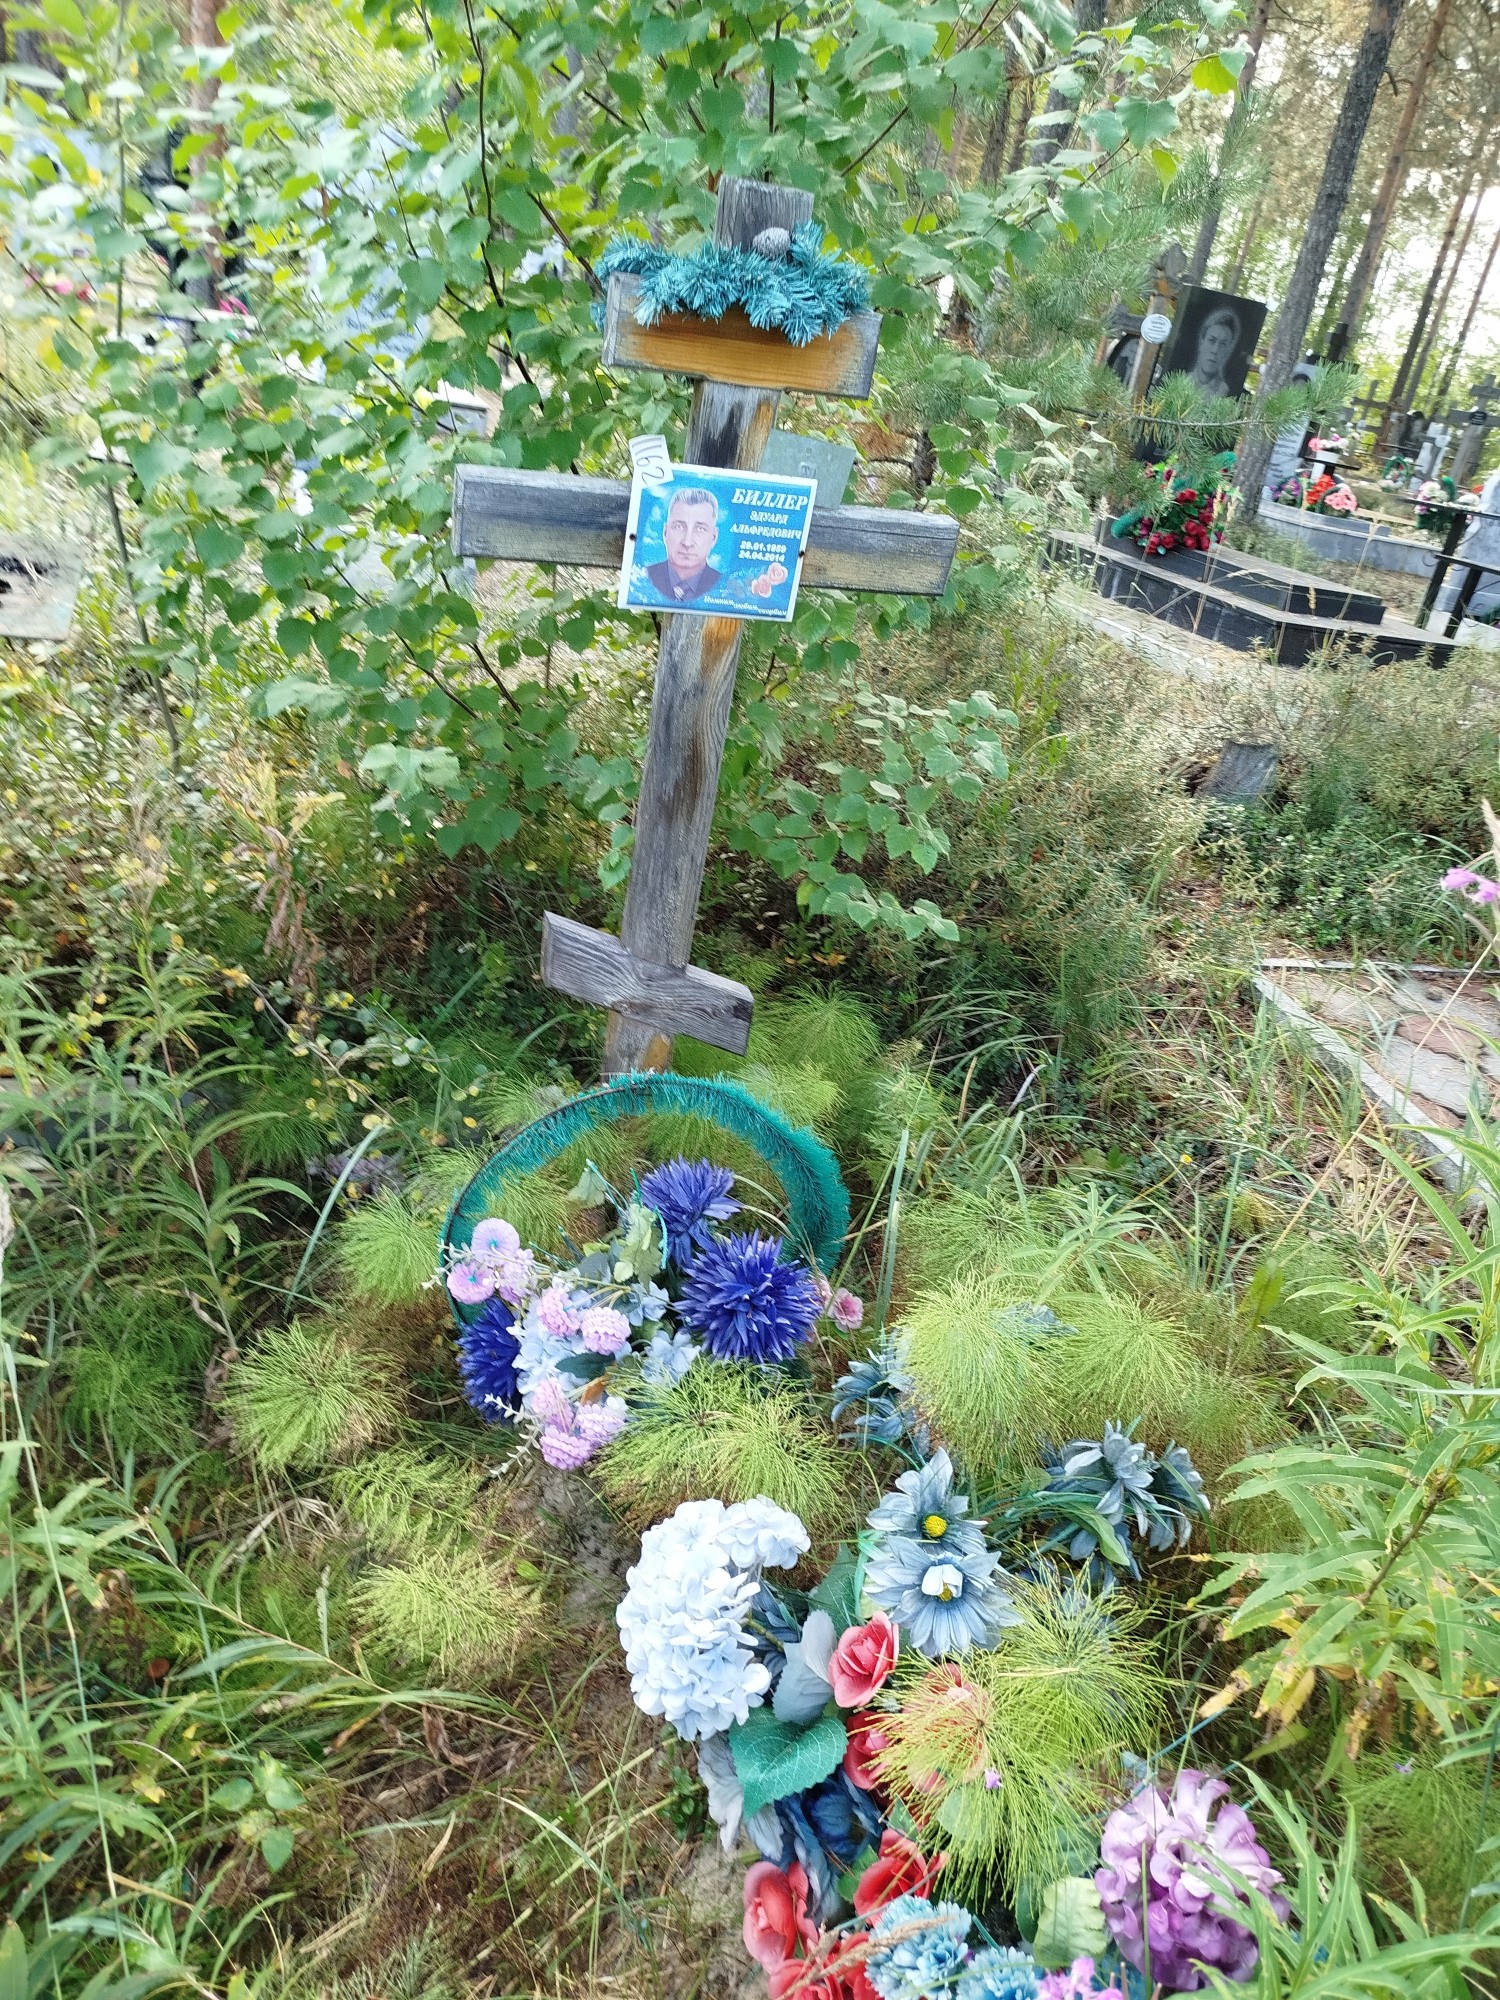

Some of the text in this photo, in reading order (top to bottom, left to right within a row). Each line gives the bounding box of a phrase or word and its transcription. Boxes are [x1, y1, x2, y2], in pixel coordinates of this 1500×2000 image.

[731, 488, 808, 511] БИЛЛЕР
[750, 511, 789, 525] ЭДУАРД
[730, 523, 802, 540] АЛЬФРЕДОВИЧ
